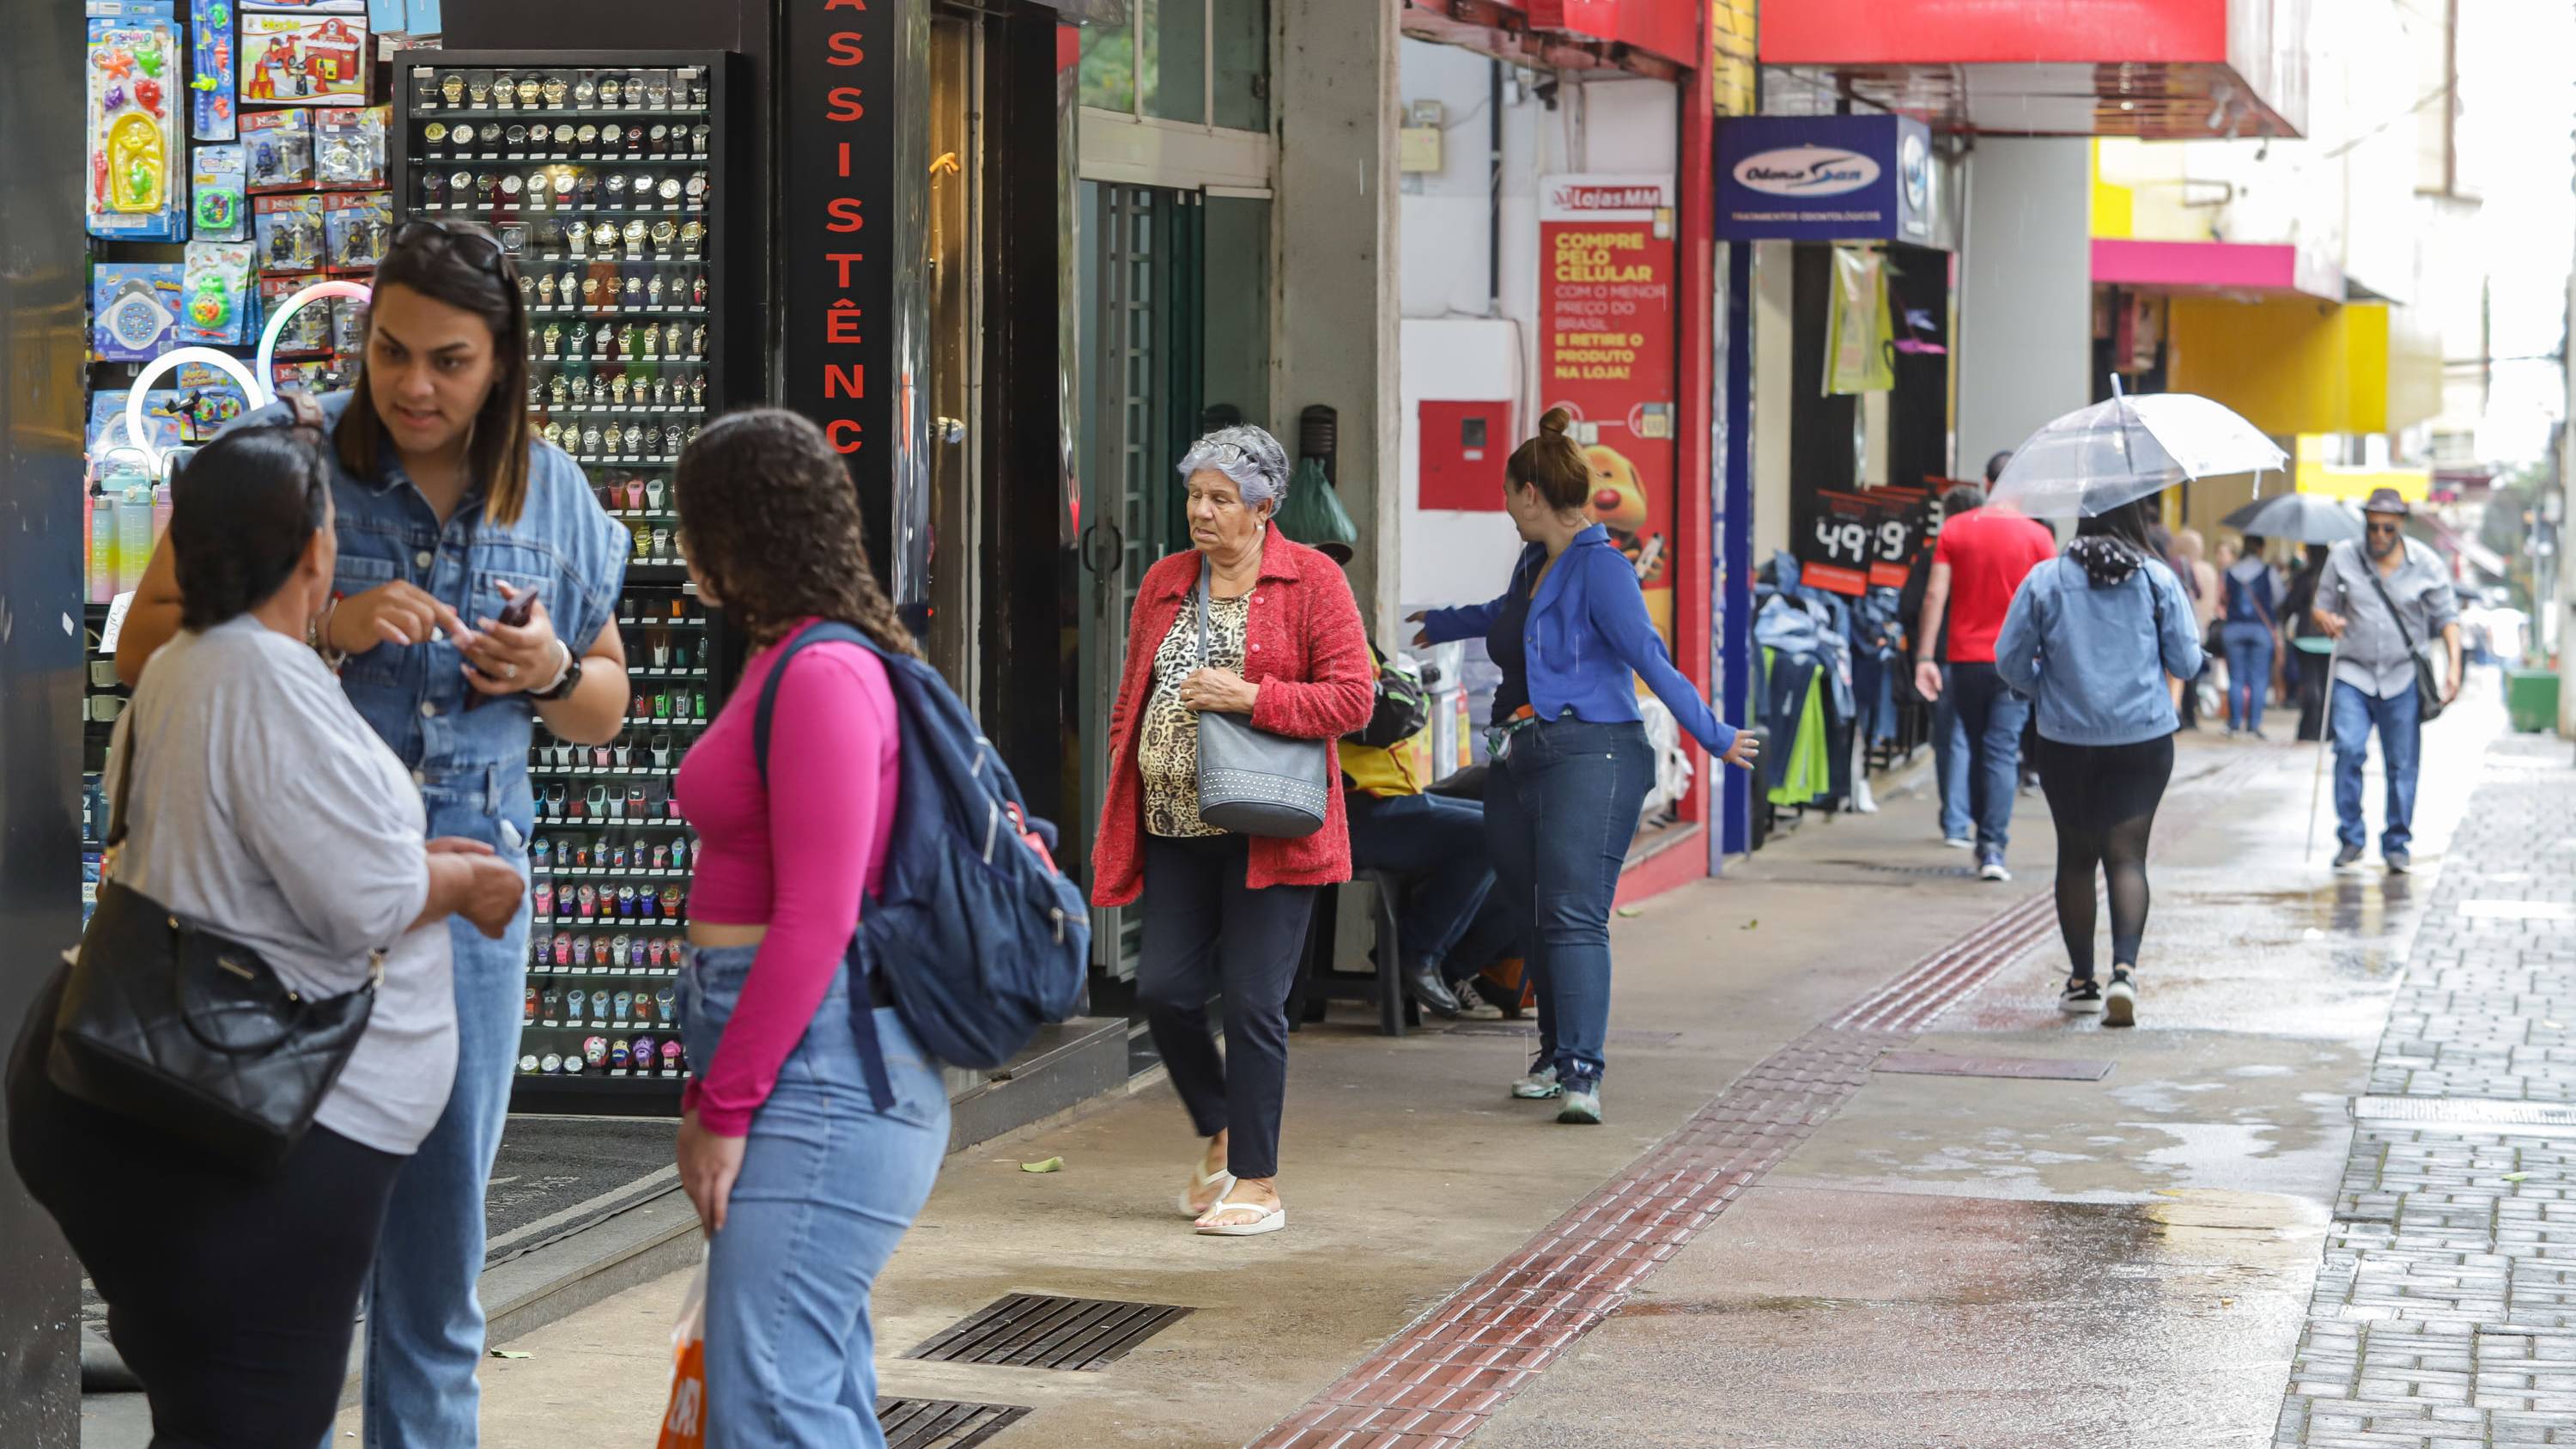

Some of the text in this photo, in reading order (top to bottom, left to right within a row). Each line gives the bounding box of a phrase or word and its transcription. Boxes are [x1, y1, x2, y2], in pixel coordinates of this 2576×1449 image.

[824, 0, 866, 454] SSISTÊNC
[1555, 233, 1644, 249] COMPRE
[1555, 249, 1610, 265] PELO
[1555, 265, 1652, 282] CELULAR
[1555, 284, 1666, 299] COM O MENOR
[1555, 300, 1636, 316] PREÇO DO
[1555, 316, 1608, 331] BRASIL
[1555, 332, 1643, 347] E RETIRE O
[1555, 349, 1635, 363] PRODUTO
[1555, 365, 1630, 380] NA LOJA!
[1816, 521, 1866, 563] 49
